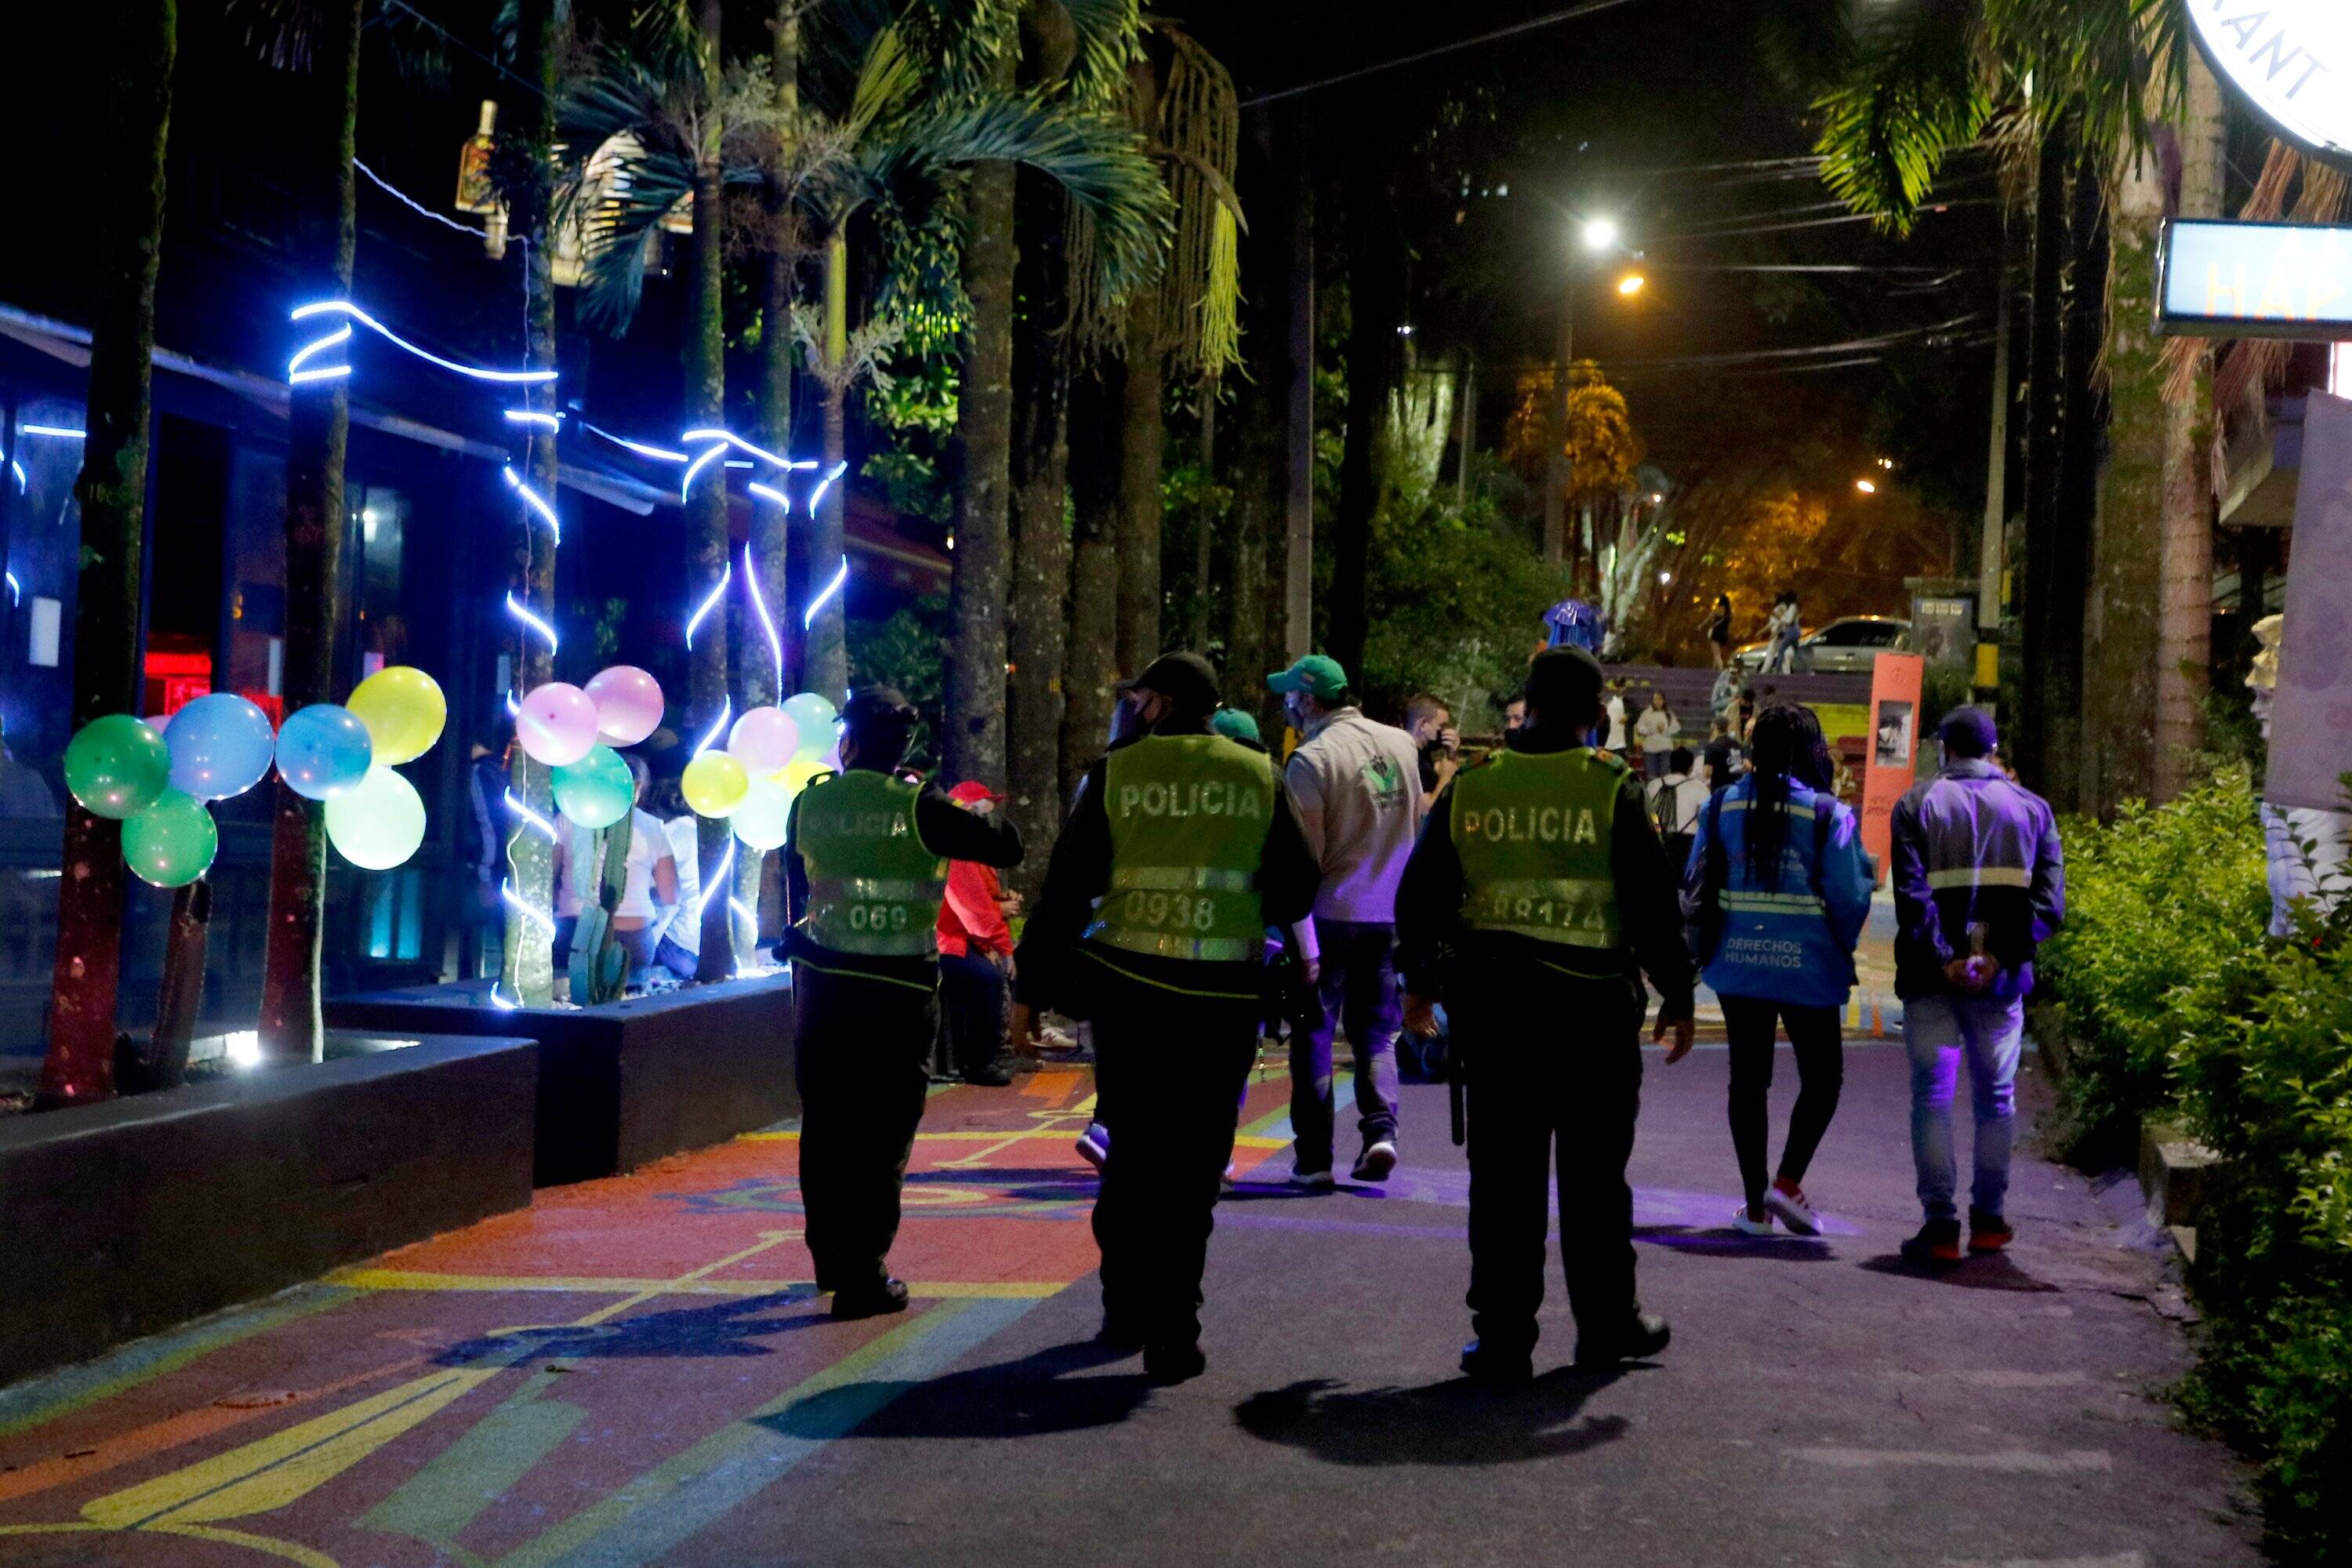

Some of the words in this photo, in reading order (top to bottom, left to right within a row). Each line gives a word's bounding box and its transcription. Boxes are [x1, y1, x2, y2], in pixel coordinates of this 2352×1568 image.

[2212, 0, 2330, 100] ANT
[1120, 782, 1261, 818] POLICIA
[807, 811, 909, 837] LICIA
[1465, 807, 1596, 844] POLICIA
[1124, 891, 1214, 931] 0938
[1726, 951, 1801, 968] HUMANOS
[1727, 938, 1802, 953] DERECHOS
